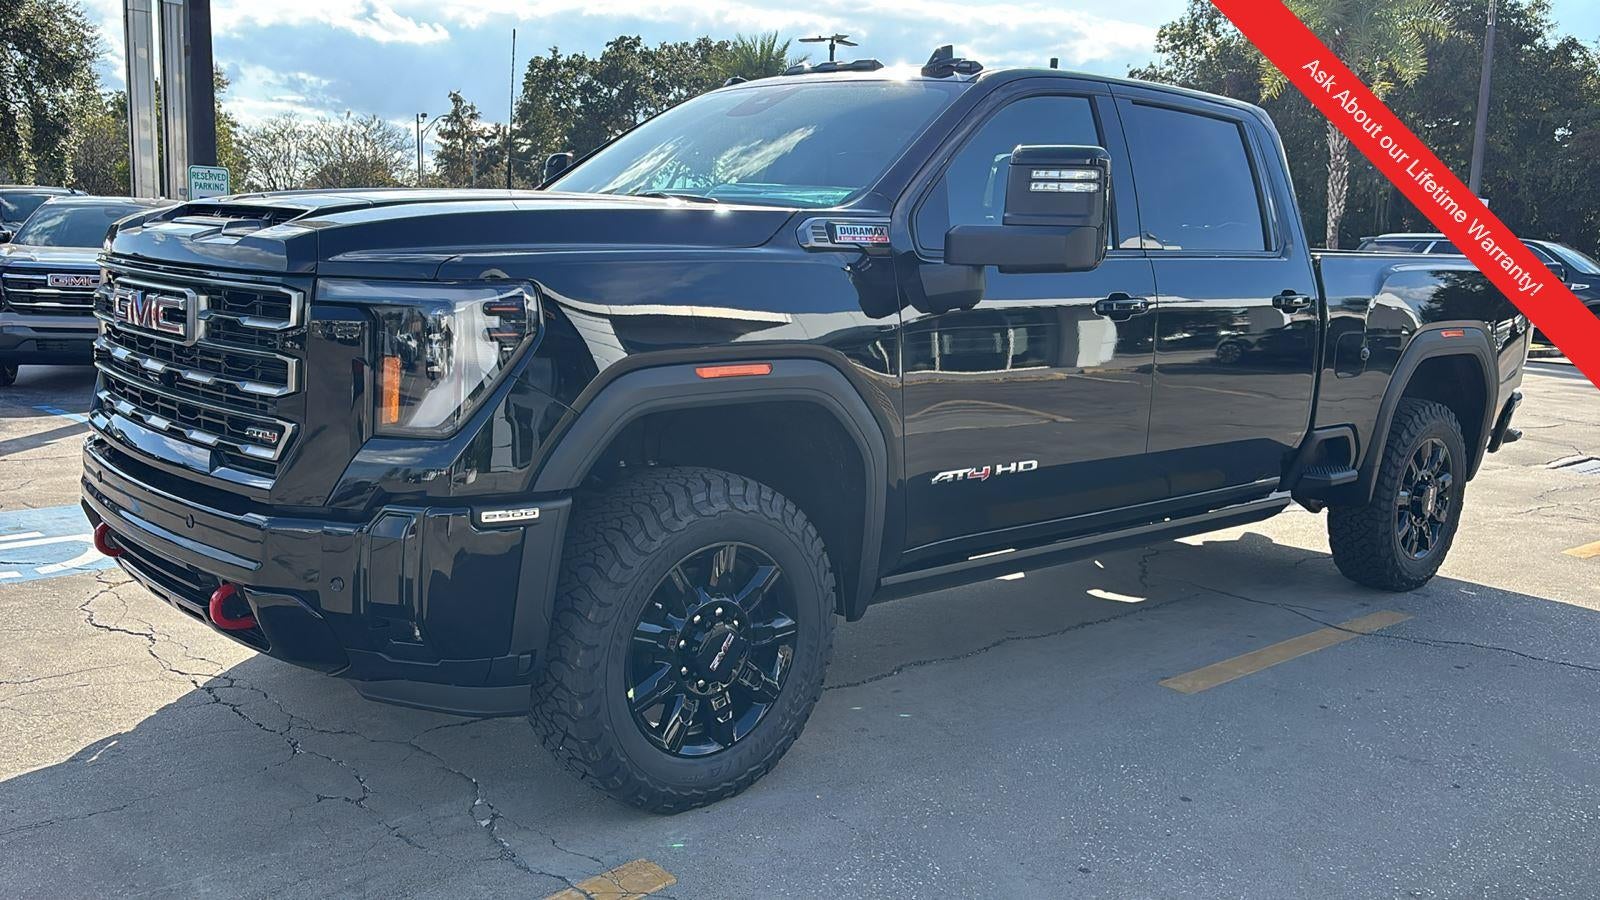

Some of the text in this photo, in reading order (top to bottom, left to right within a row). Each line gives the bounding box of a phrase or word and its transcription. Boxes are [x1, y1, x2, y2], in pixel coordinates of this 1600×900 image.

[191, 171, 227, 181] RESERVED
[194, 182, 225, 191] PARKING
[840, 226, 885, 236] DURAMAX
[114, 287, 186, 336] GMC
[931, 460, 1038, 484] AT4 HD
[481, 508, 540, 522] 2500
